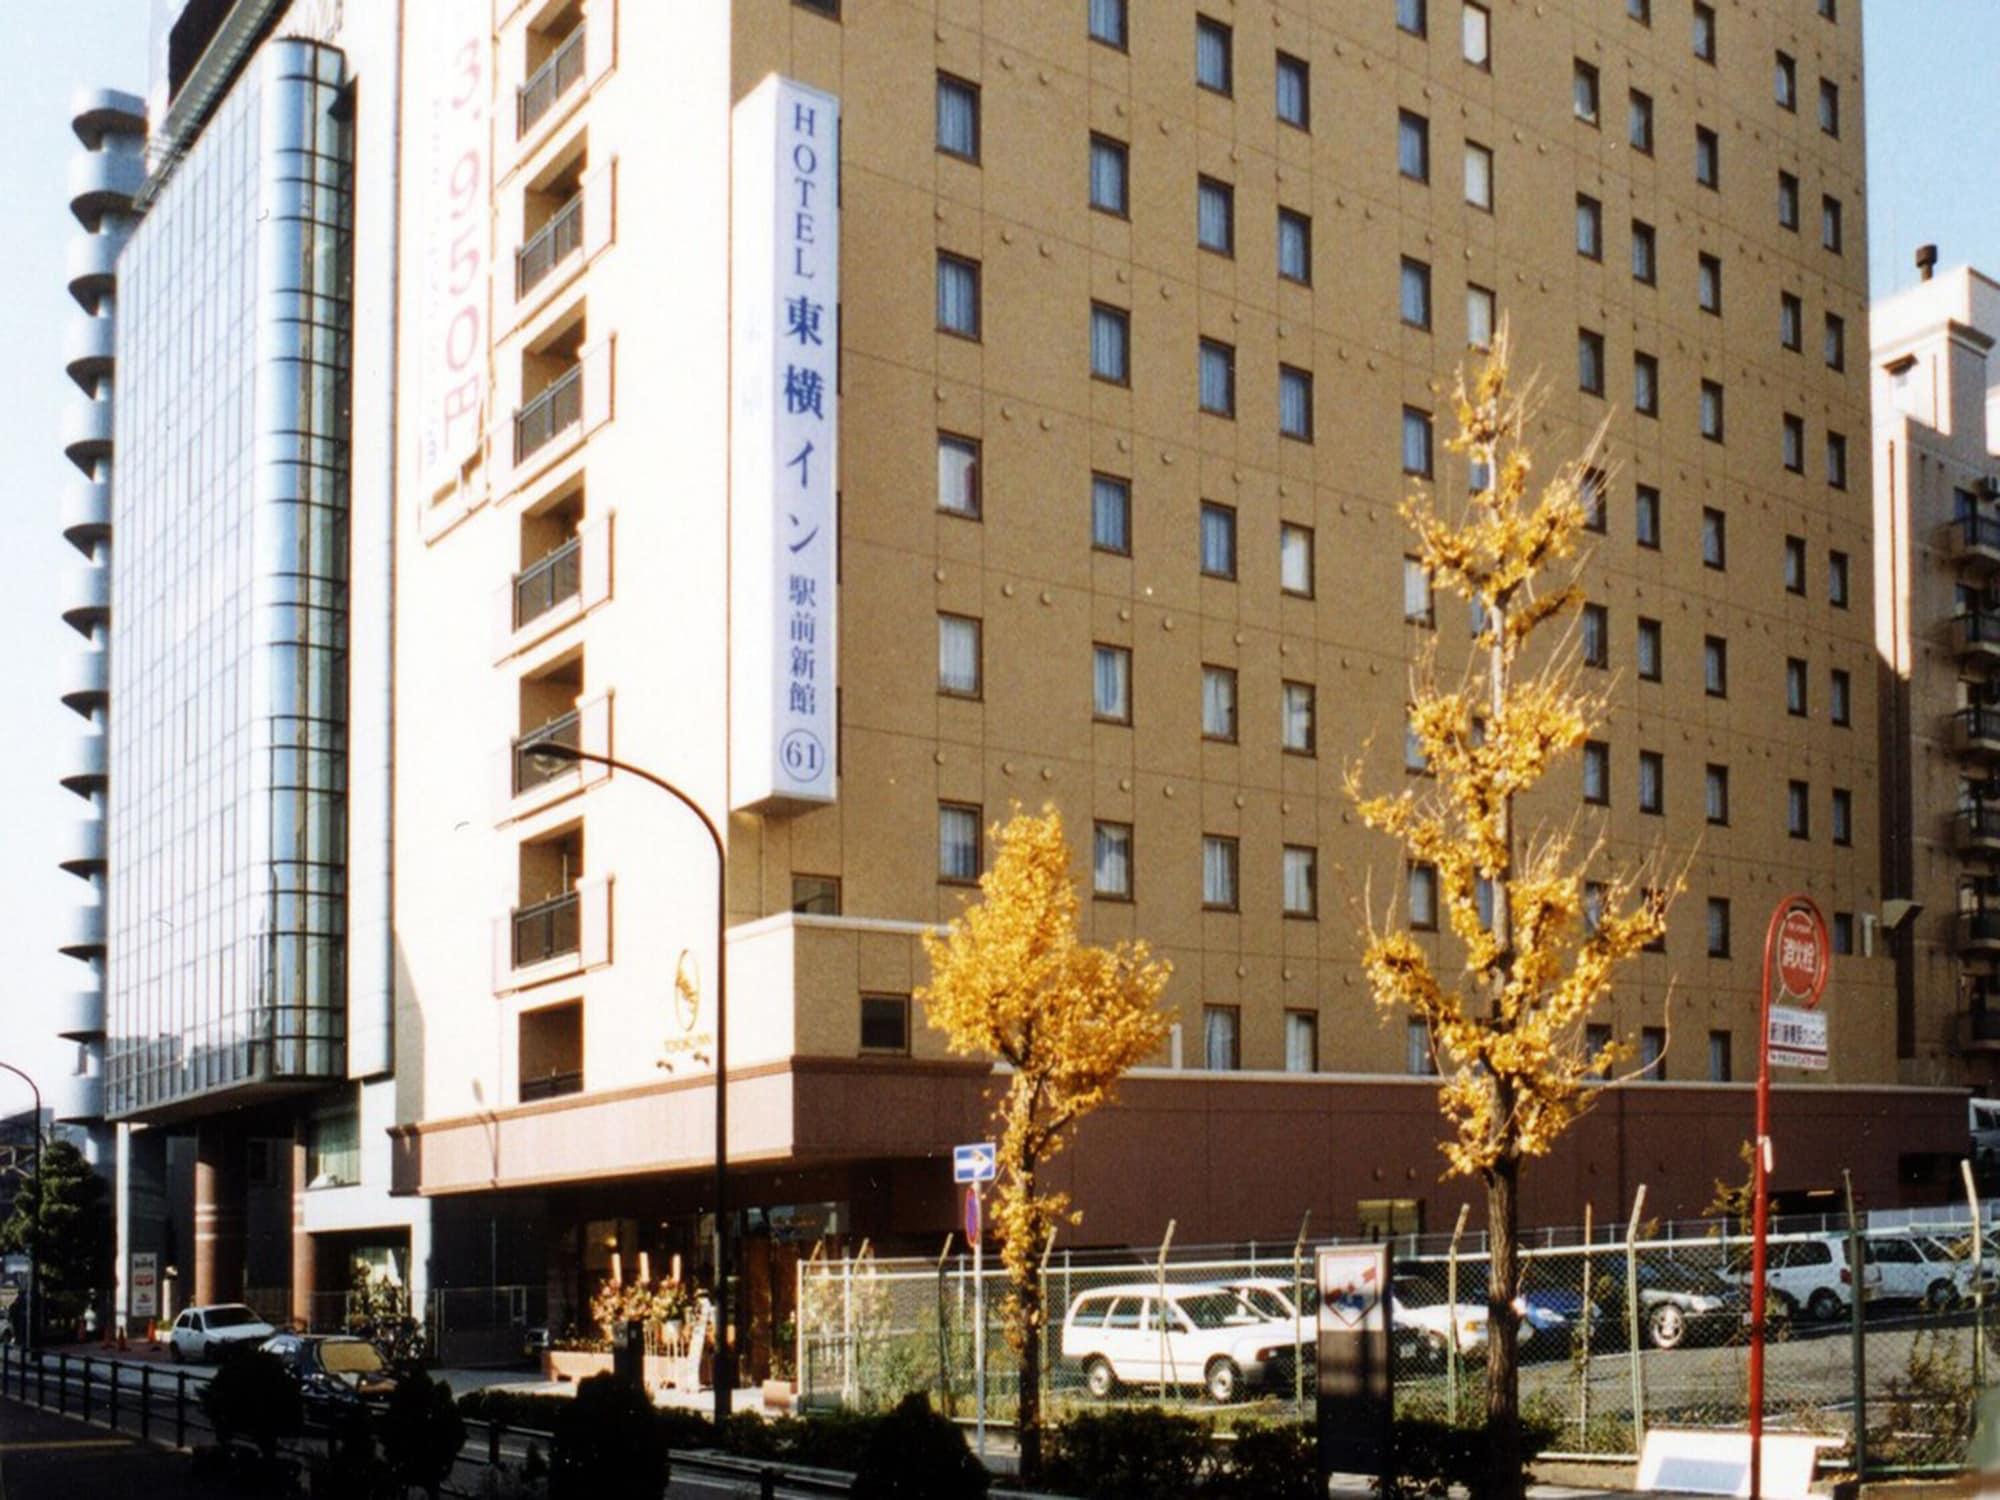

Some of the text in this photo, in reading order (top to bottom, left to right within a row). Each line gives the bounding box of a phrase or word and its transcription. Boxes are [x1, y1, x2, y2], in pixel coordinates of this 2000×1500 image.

[793, 103, 817, 279] HOTEL
[783, 295, 825, 555] 東横イン
[788, 573, 817, 716] 駅前新館
